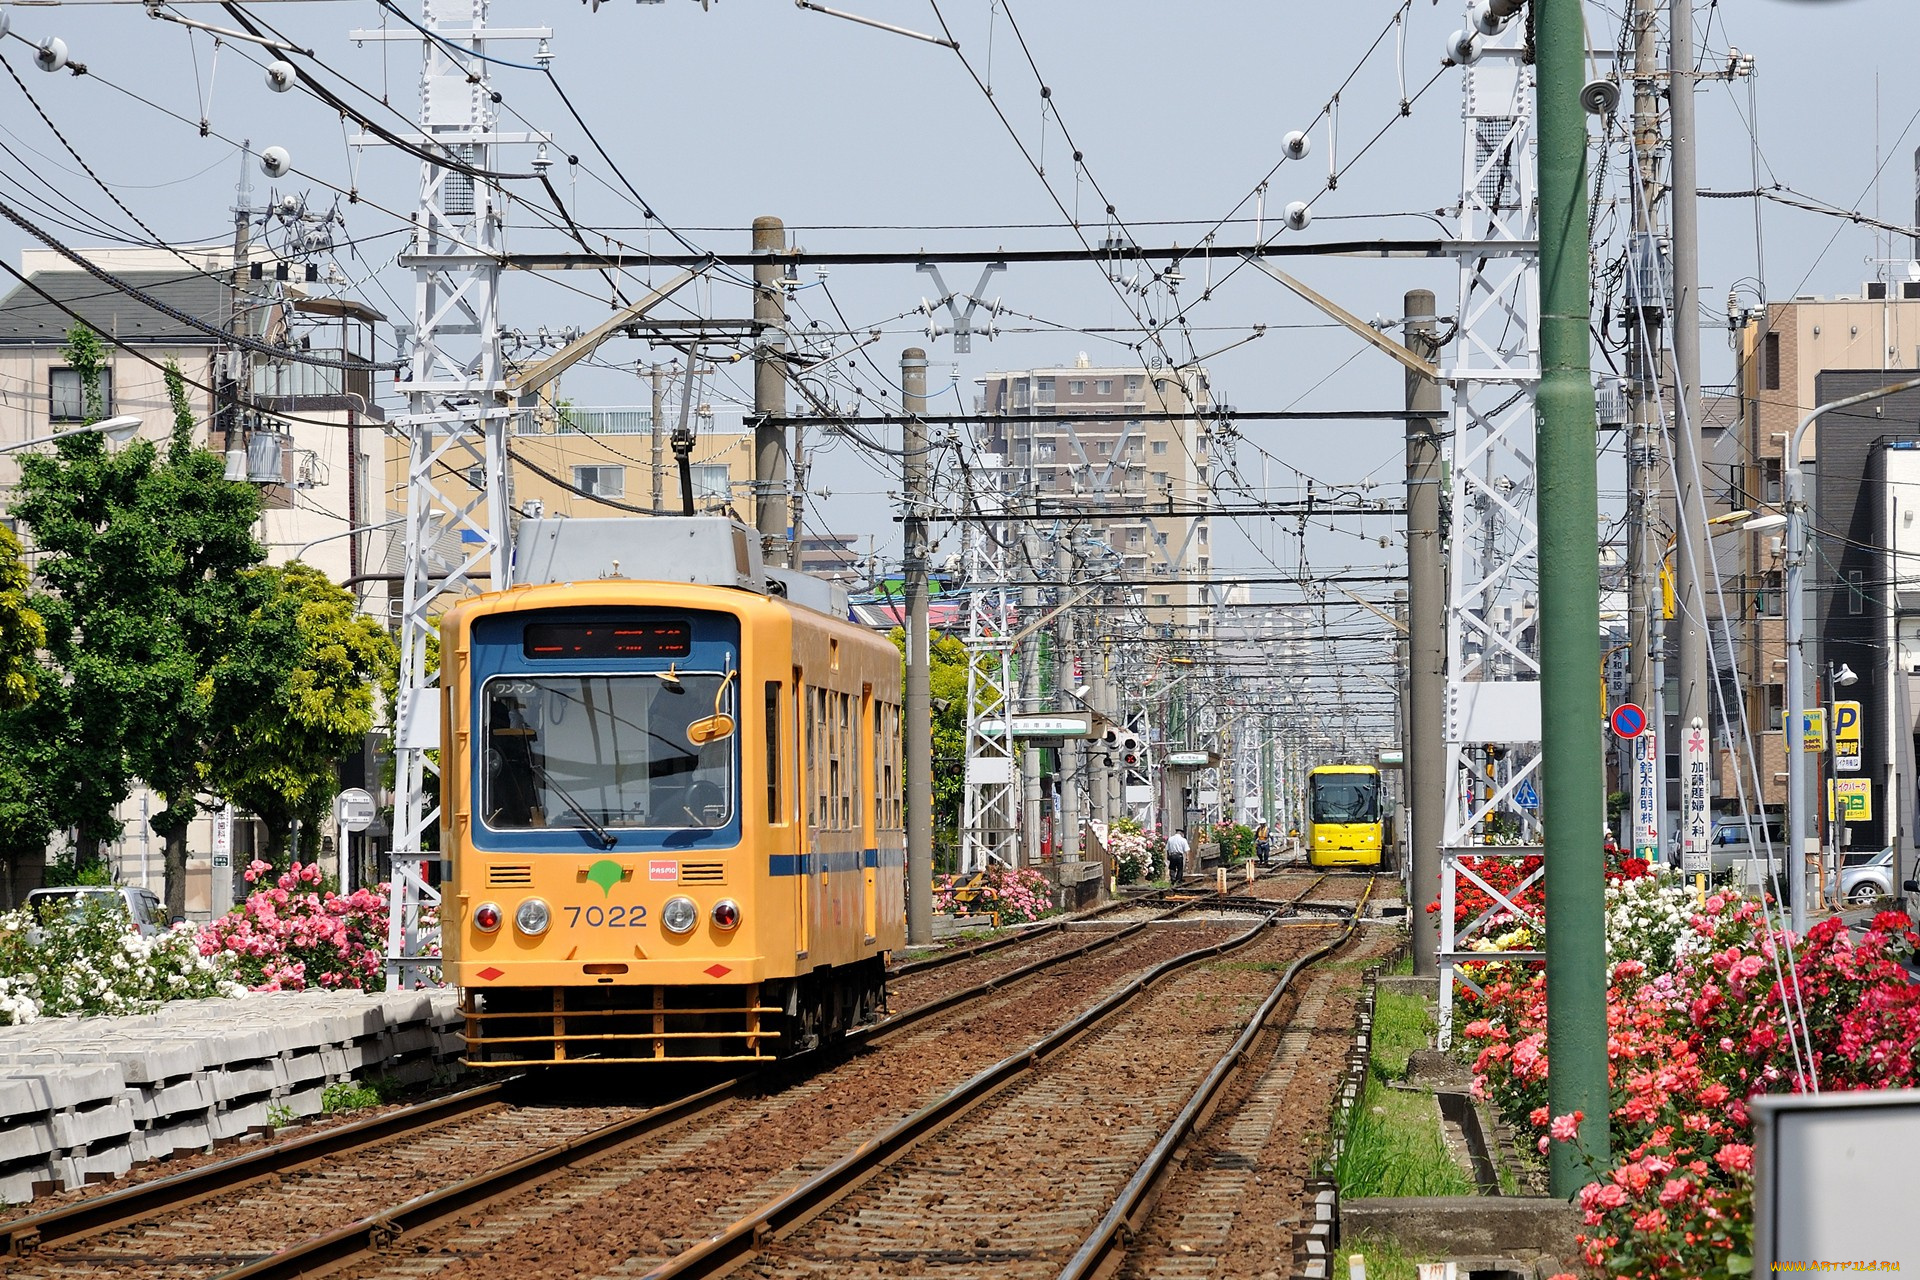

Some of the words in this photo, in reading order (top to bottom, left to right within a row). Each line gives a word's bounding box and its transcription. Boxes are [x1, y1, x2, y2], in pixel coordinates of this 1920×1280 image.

[495, 683, 536, 694] ワンマン
[1835, 708, 1857, 736] P
[1838, 782, 1867, 793] イクパーク
[1690, 761, 1705, 838] 加藤産婦人科
[563, 905, 647, 928] 7022
